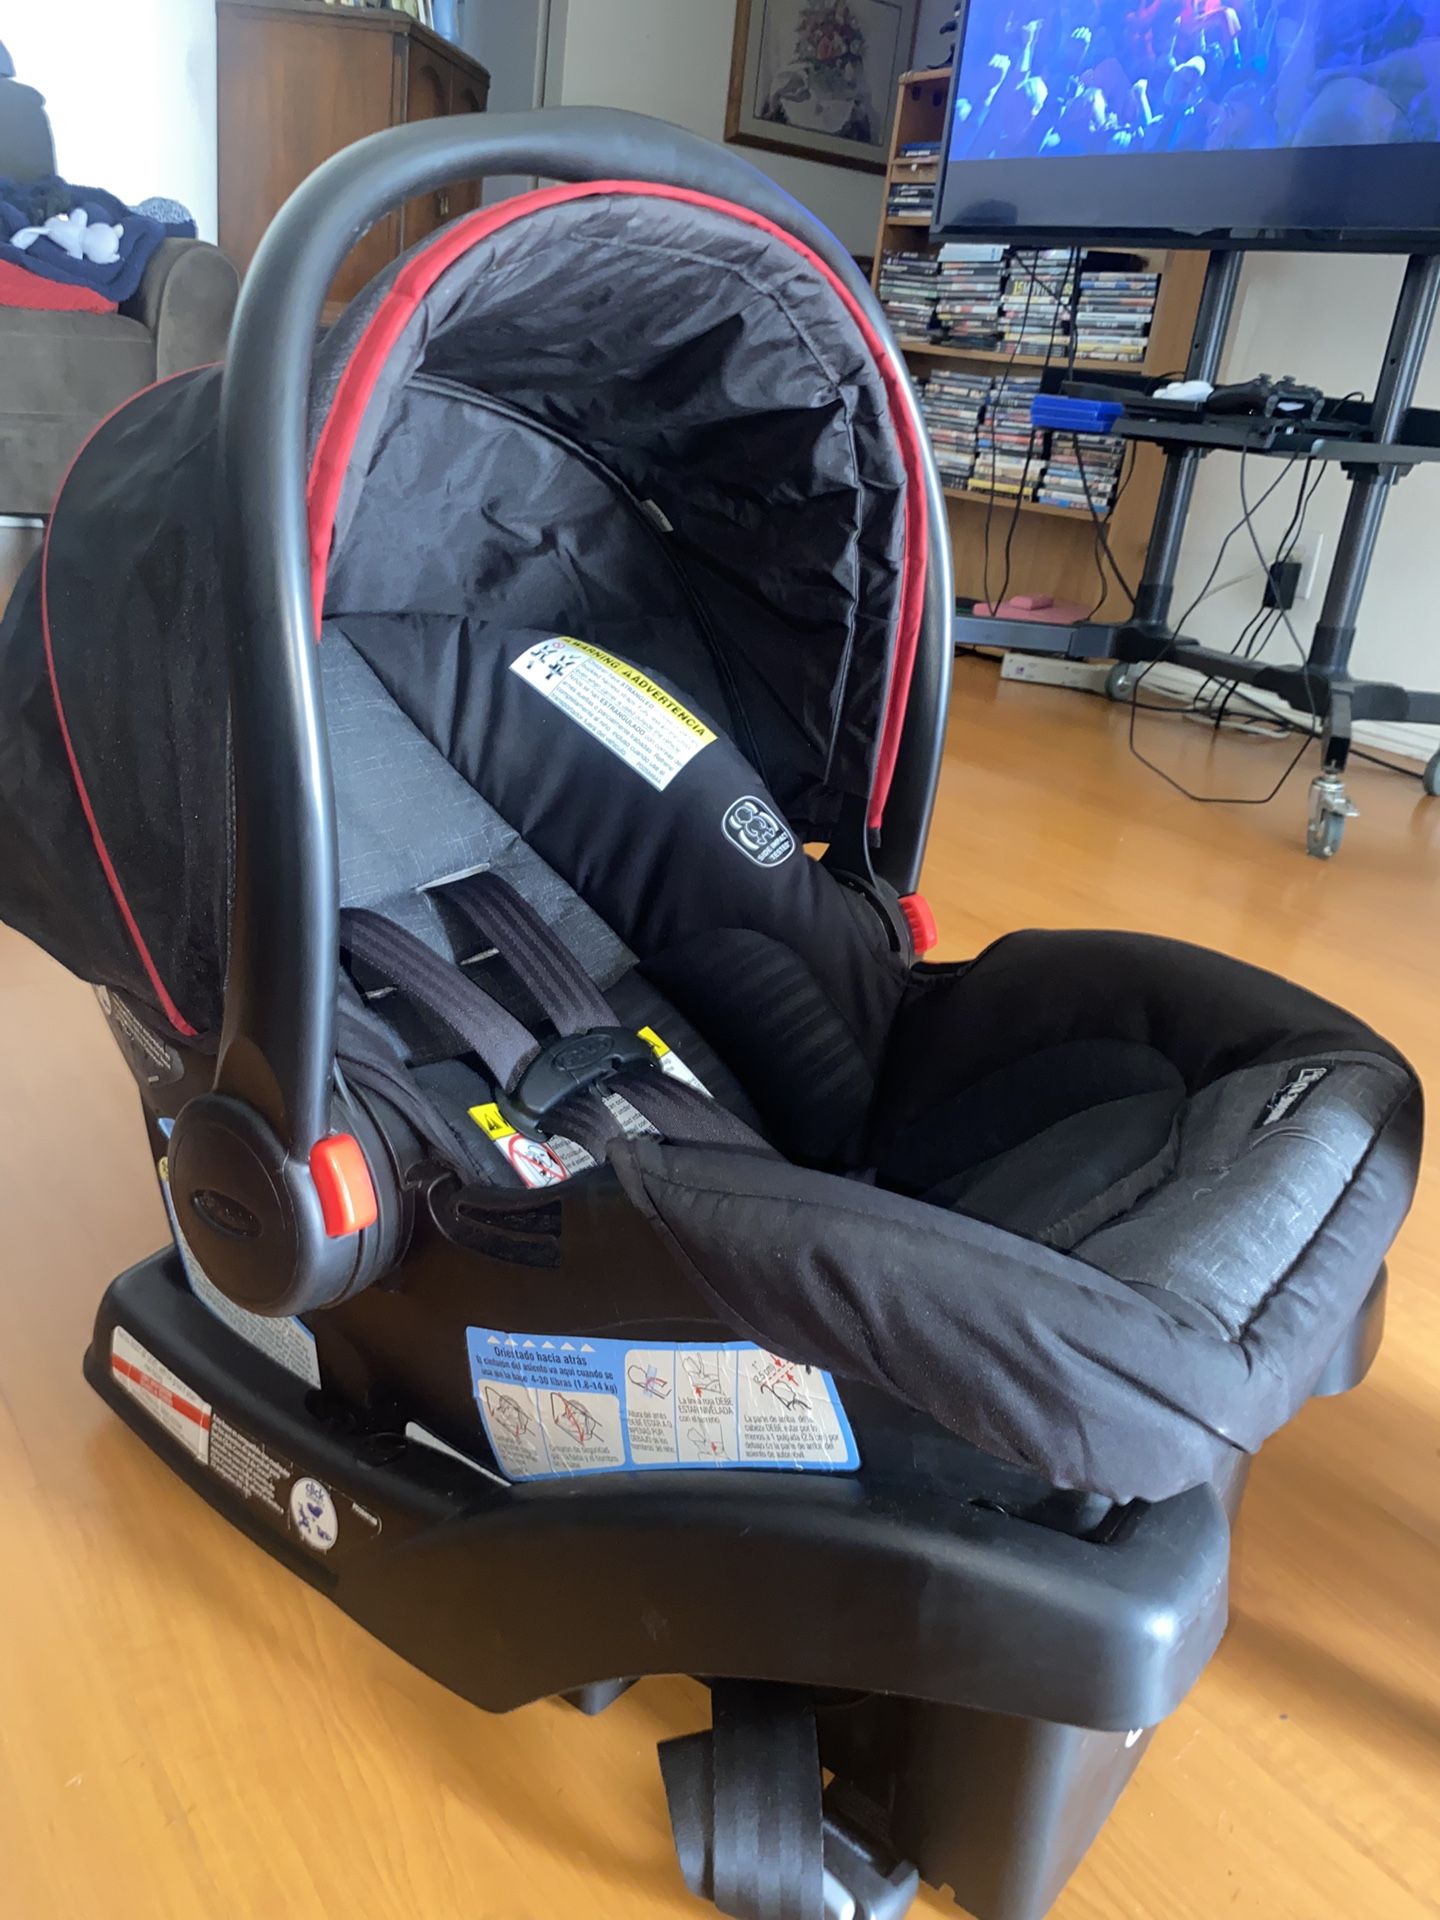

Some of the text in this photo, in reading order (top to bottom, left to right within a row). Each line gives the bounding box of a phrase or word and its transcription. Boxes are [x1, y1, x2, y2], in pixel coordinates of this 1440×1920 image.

[572, 641, 620, 669] WARNING
[599, 697, 646, 736] ESTRANGULADO
[631, 674, 706, 737] ADVERTENCIA
[537, 1352, 561, 1364] hacia
[564, 1354, 588, 1366] atrás
[531, 1374, 549, 1385] 4-30
[604, 1382, 618, 1394] kg)
[576, 1368, 603, 1379] cuando
[605, 1371, 614, 1380] se
